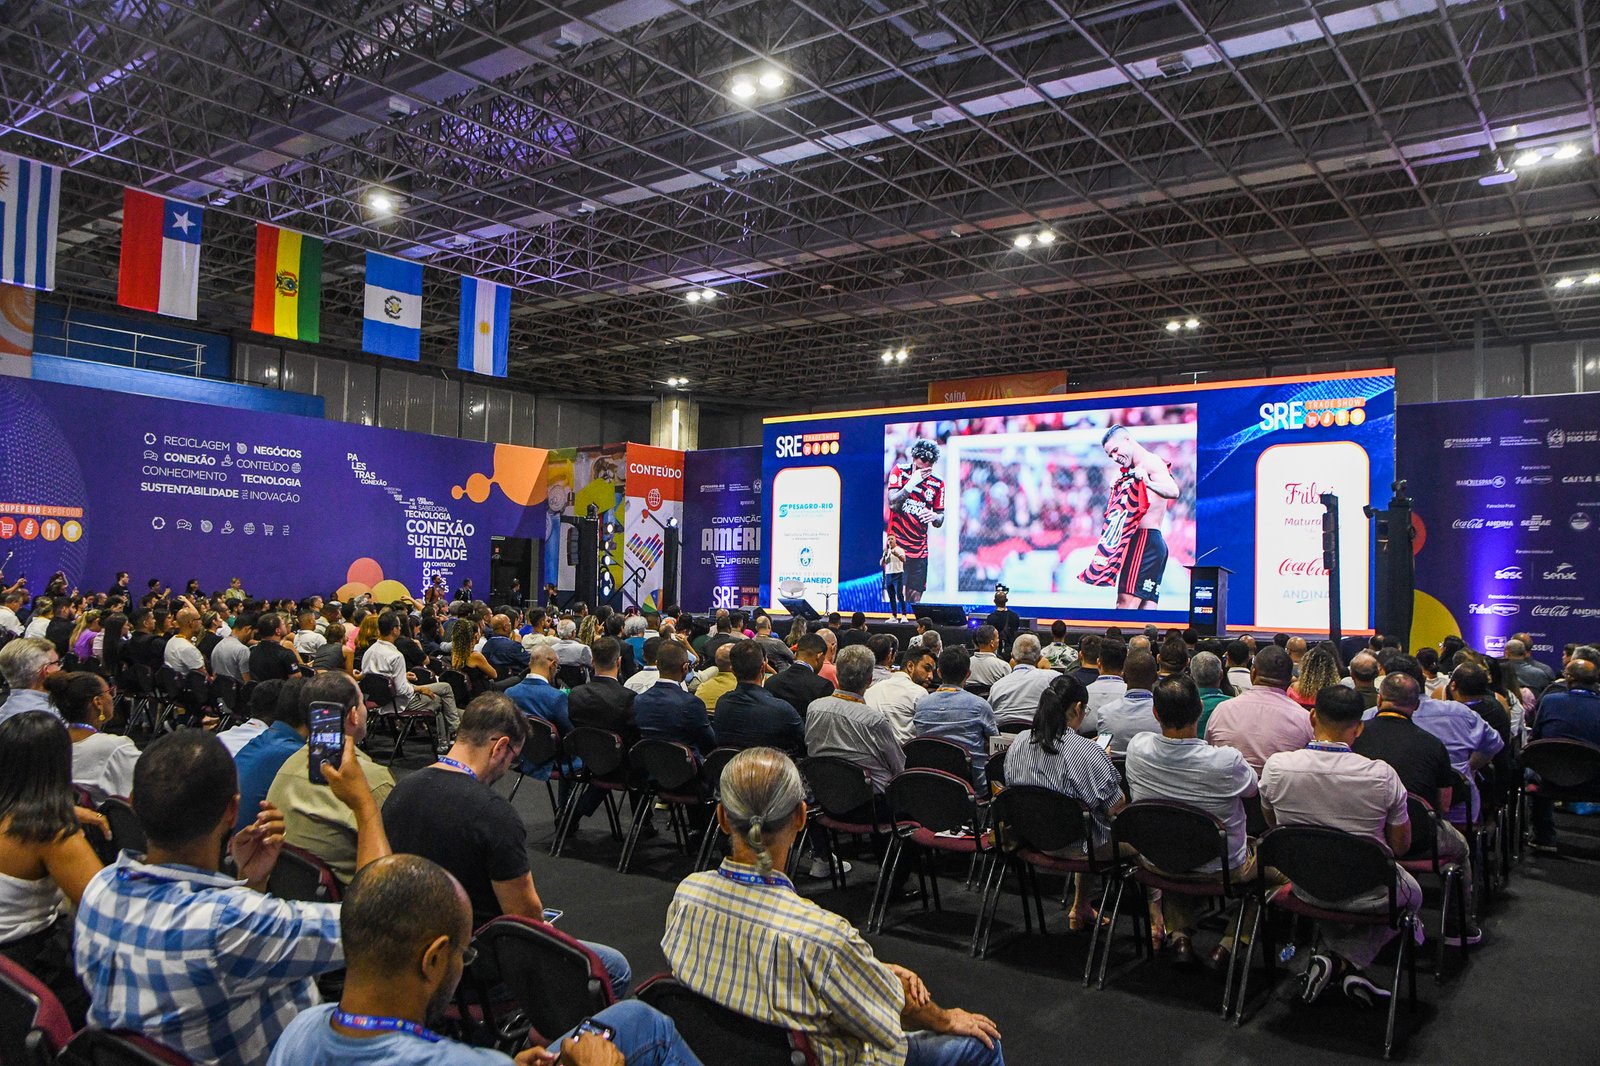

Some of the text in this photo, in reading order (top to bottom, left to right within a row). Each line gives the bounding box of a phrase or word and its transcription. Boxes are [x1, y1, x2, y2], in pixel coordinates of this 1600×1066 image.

[1260, 400, 1361, 430] SRE TRADE SHOW
[164, 436, 302, 458] RECICLAGEM NEGÓCIOS
[776, 435, 802, 458] SRE
[164, 452, 289, 473] CONEXÃO CONTEÚDO
[347, 453, 358, 461] PA
[351, 462, 366, 471] LES
[354, 470, 376, 479] TRAS
[630, 461, 682, 479] CONTEÚDO
[142, 465, 301, 487] CONHECIMENTO TECNOLOGIA
[361, 478, 387, 487] CONEXÃO
[140, 482, 300, 503] SUSTENTABILIDADE INOVAÇÃO
[1285, 482, 1334, 505] Frib
[0, 503, 25, 513] SUPER
[27, 505, 41, 513] RIO
[404, 510, 451, 520] TECNOLOGIA
[406, 520, 475, 537] CONEXÃO
[1285, 518, 1323, 526] Matura
[407, 534, 466, 549] SUSTENTA
[415, 547, 468, 561] BILIDADE
[712, 586, 739, 608] SRE
[1531, 644, 1554, 653] SSERJ
